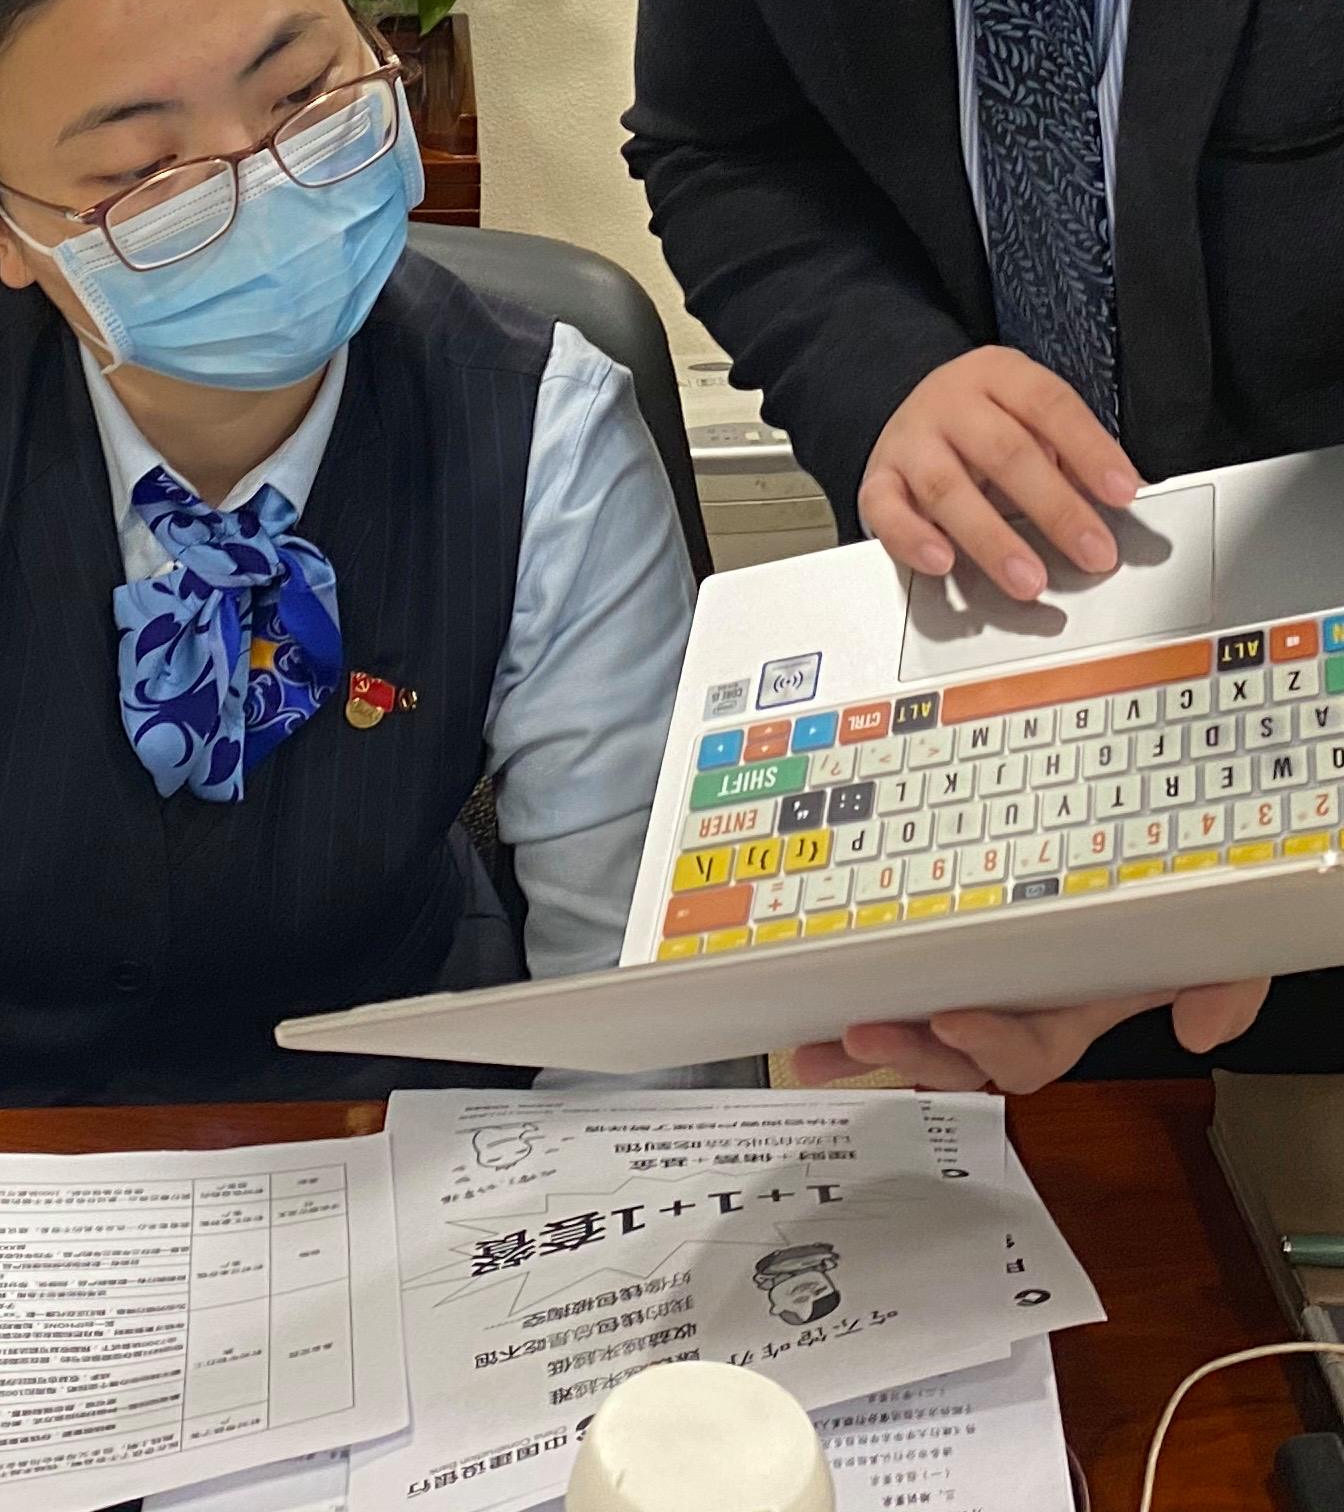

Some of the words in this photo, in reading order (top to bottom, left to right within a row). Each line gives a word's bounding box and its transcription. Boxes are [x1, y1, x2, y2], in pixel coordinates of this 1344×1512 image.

[1223, 640, 1258, 661] ALT
[1234, 681, 1246, 700] X
[1289, 671, 1300, 690] Z
[1181, 689, 1193, 709] C
[897, 699, 932, 723] ALT
[1076, 709, 1088, 728] B
[1127, 700, 1139, 720] V
[1315, 707, 1328, 727] A
[849, 712, 880, 730] CTRL
[1024, 718, 1037, 738] N
[1261, 717, 1272, 737] S
[972, 727, 989, 748] M
[1154, 735, 1164, 757] F
[1206, 726, 1219, 746] D
[1047, 754, 1059, 775] H
[1100, 746, 1111, 766] G
[1333, 748, 1344, 768] Q
[1222, 767, 1233, 788] E
[1274, 757, 1292, 779] W
[718, 767, 777, 796] SHIFT
[896, 782, 906, 801] L
[944, 773, 957, 793] K
[1167, 776, 1178, 797] R
[1058, 795, 1070, 816] Y
[1112, 786, 1123, 807] T
[1316, 794, 1329, 816] 2
[700, 810, 757, 837] ENTER
[1005, 804, 1018, 825] U
[1203, 814, 1215, 835] 4
[1259, 804, 1272, 825] 3
[852, 831, 864, 851] P
[1093, 832, 1105, 853] 6
[1148, 823, 1160, 844] 5
[985, 850, 997, 871] 8
[1039, 841, 1050, 862] 7
[933, 859, 945, 880] 9
[471, 1184, 845, 1277] 1+1+1套餐
[474, 1294, 694, 1369] 我的钱包总是吃不饱
[546, 1323, 697, 1377] 收益越来越低
[406, 1434, 568, 1498] 中国建设银行
